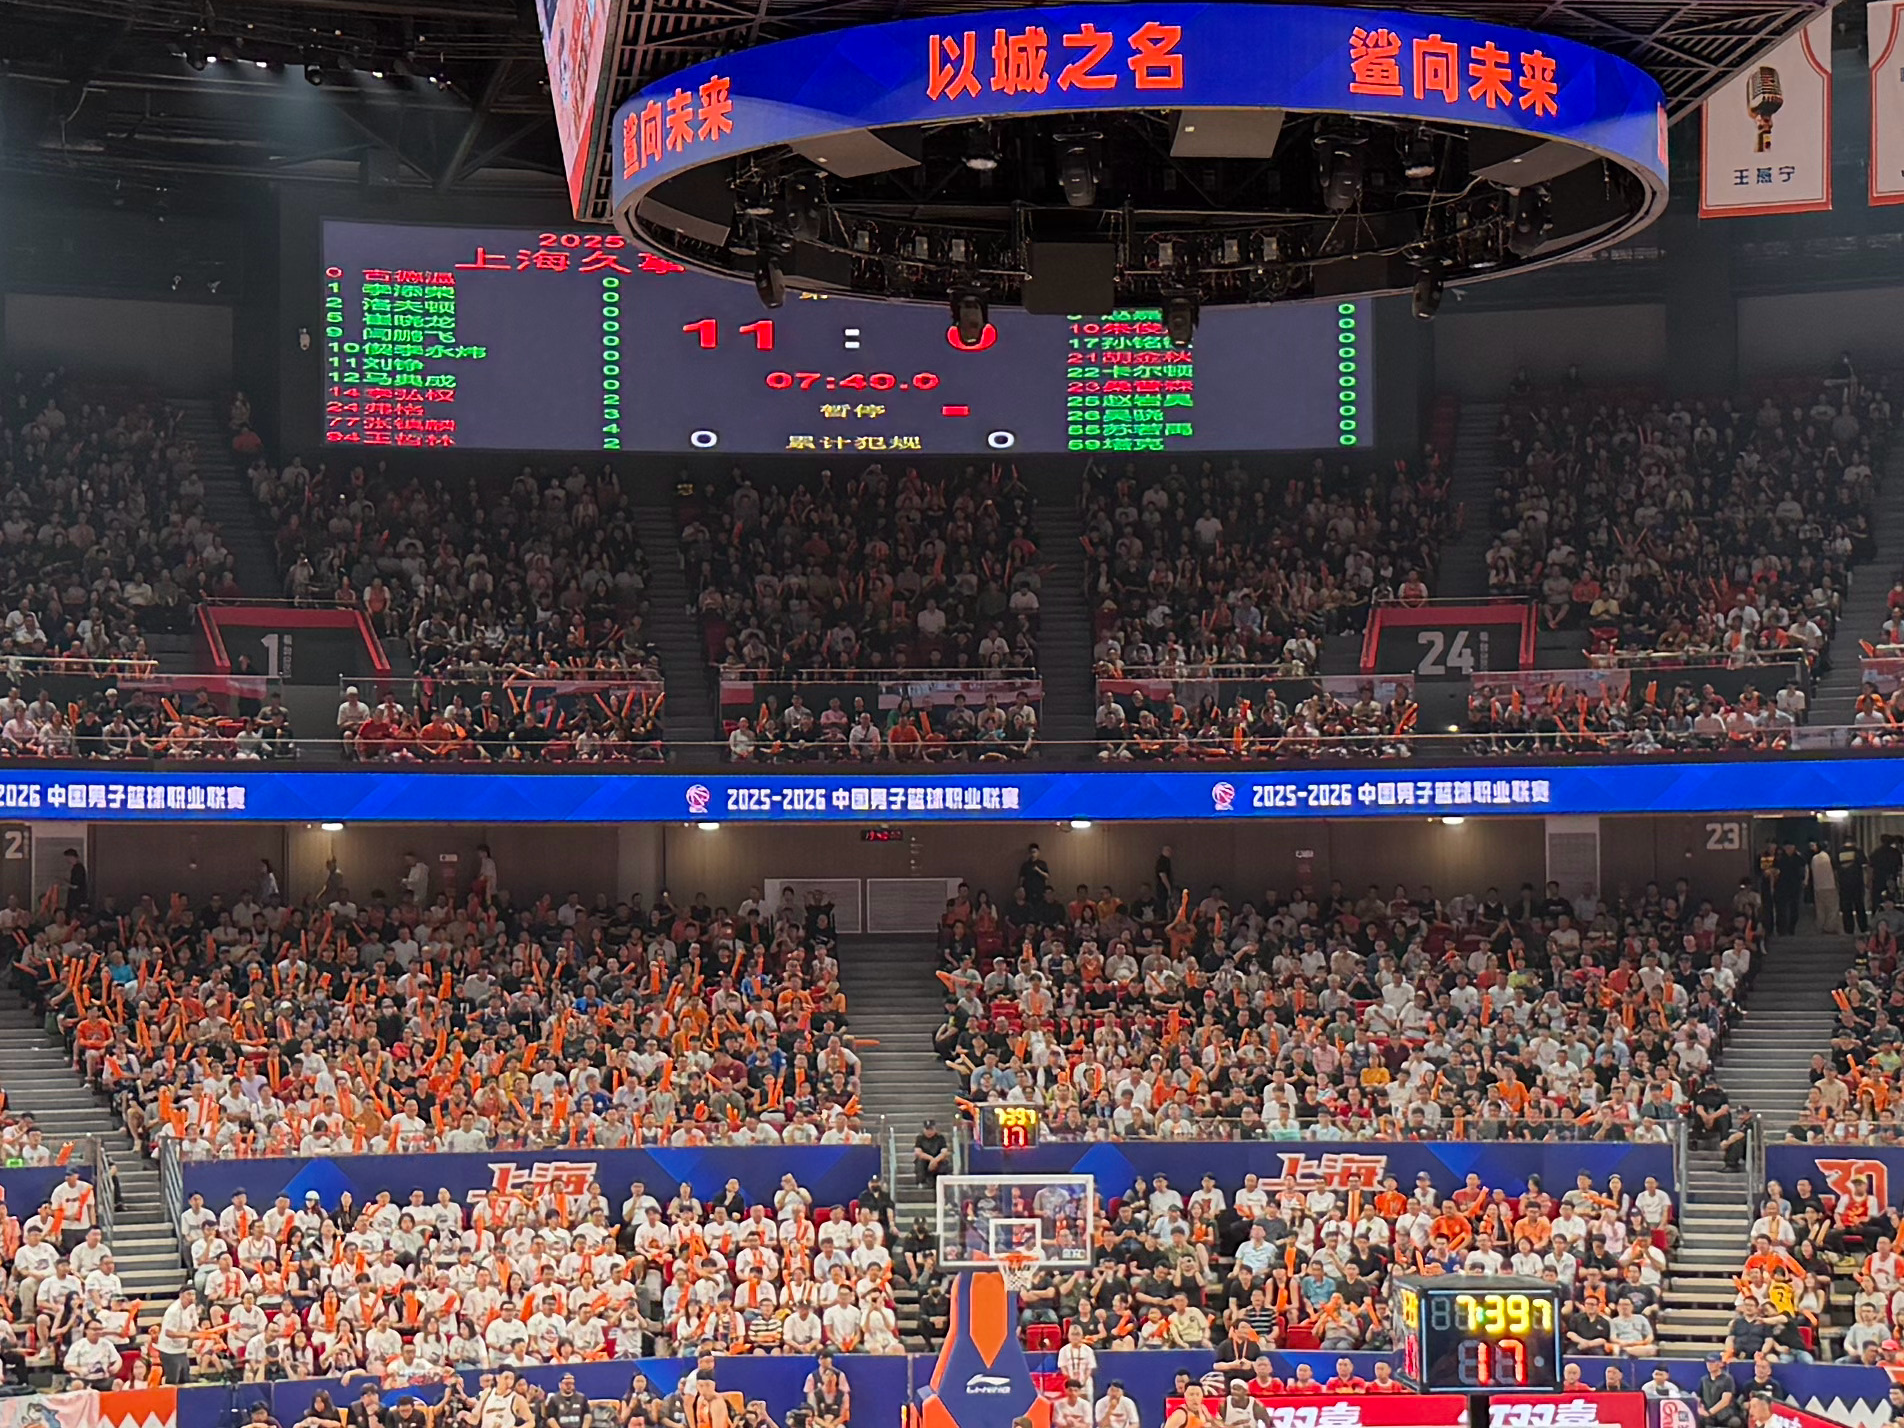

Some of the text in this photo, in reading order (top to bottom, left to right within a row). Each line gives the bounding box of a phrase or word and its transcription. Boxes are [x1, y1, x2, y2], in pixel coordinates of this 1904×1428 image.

[927, 21, 1184, 102] 以城之名
[1349, 26, 1560, 118] 鲨向未来
[623, 75, 734, 180] 鲨向未来
[682, 319, 775, 351] 11
[261, 633, 279, 678] 1
[1417, 631, 1475, 675] 24
[46, 783, 247, 812] 中国男子篮球职业联赛
[726, 784, 1020, 810] 2025-2026 中国男子篮球职业联赛
[1252, 780, 1551, 807] 2025-2026 中国男子篮球职业联赛
[5, 831, 23, 859] 2
[1706, 822, 1740, 851] 23
[1476, 1338, 1527, 1385] 17
